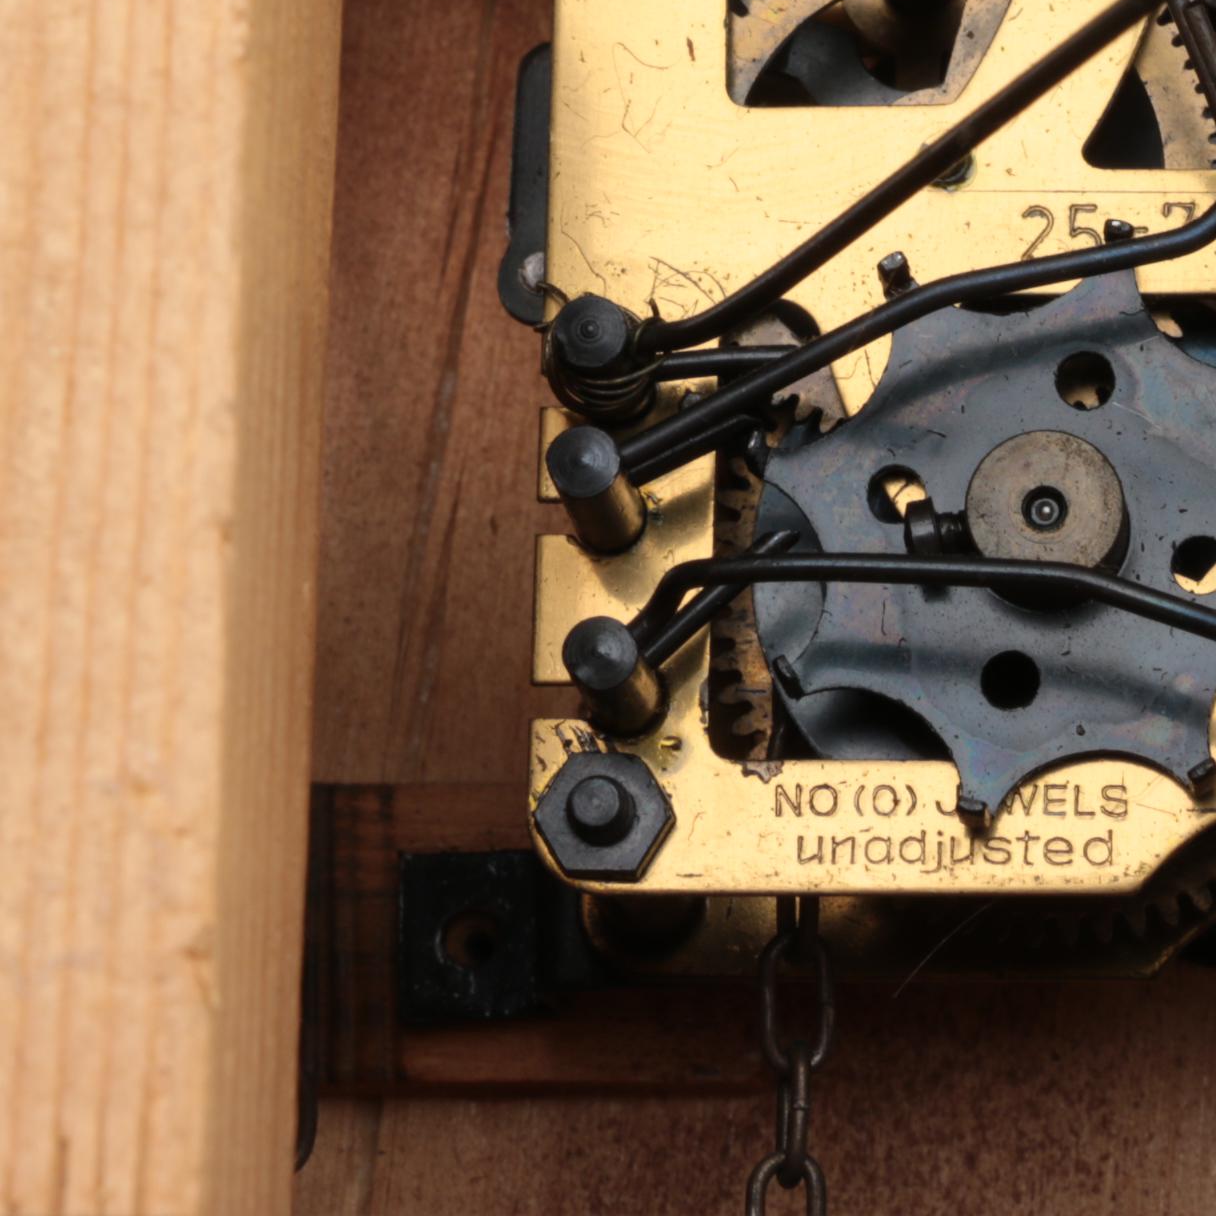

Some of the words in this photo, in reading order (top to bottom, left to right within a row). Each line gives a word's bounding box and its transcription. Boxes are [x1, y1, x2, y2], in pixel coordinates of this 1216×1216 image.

[774, 784, 838, 817] NO
[935, 784, 1129, 817] JWELS
[797, 829, 1114, 874] unadjusted
